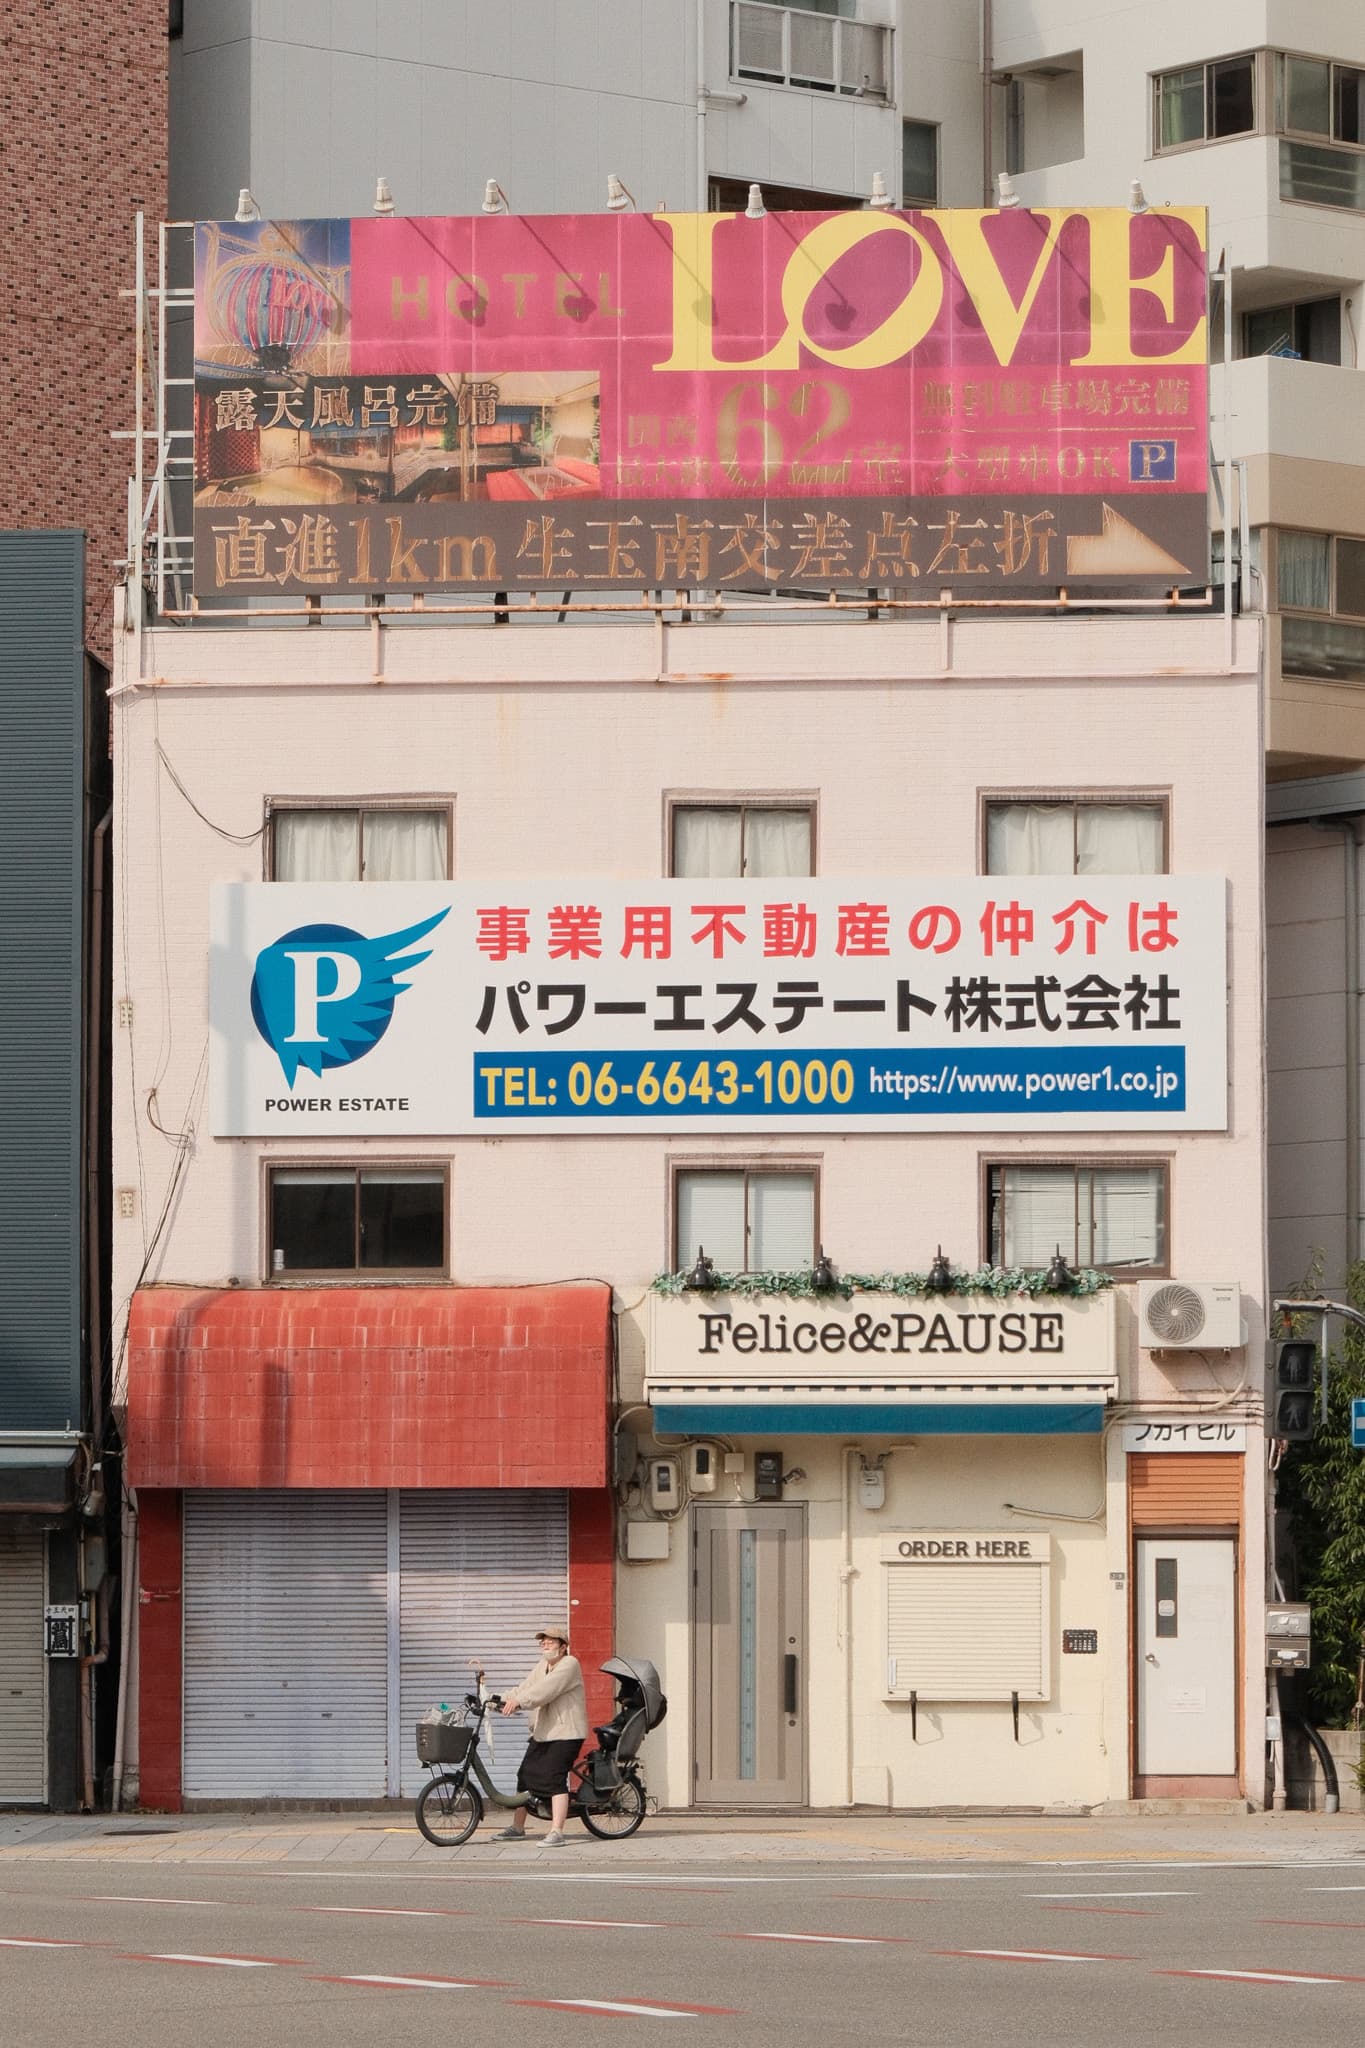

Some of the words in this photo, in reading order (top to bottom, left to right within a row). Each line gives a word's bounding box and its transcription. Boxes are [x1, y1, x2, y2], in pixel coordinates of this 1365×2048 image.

[391, 272, 626, 321] HOTEL
[652, 208, 1208, 371] LOVE
[214, 383, 500, 431] 露天風呂完備
[1138, 444, 1167, 478] P
[516, 509, 1058, 582] 生玉南交差点左折
[475, 899, 1180, 962] 事業用不動産の仲介は
[282, 950, 363, 1044] P
[474, 973, 1182, 1036] パワーエステート株式会社
[265, 1098, 333, 1113] POWER
[338, 1097, 410, 1112] ESTATE
[480, 1067, 557, 1107] TEL:
[568, 1058, 855, 1107] 06-6643-1000
[869, 1065, 1179, 1101] https://www.power1.co.jp
[697, 1312, 1065, 1355] Felice&PAUSE
[898, 1540, 969, 1558] ORDER
[975, 1540, 1031, 1558] HERE
